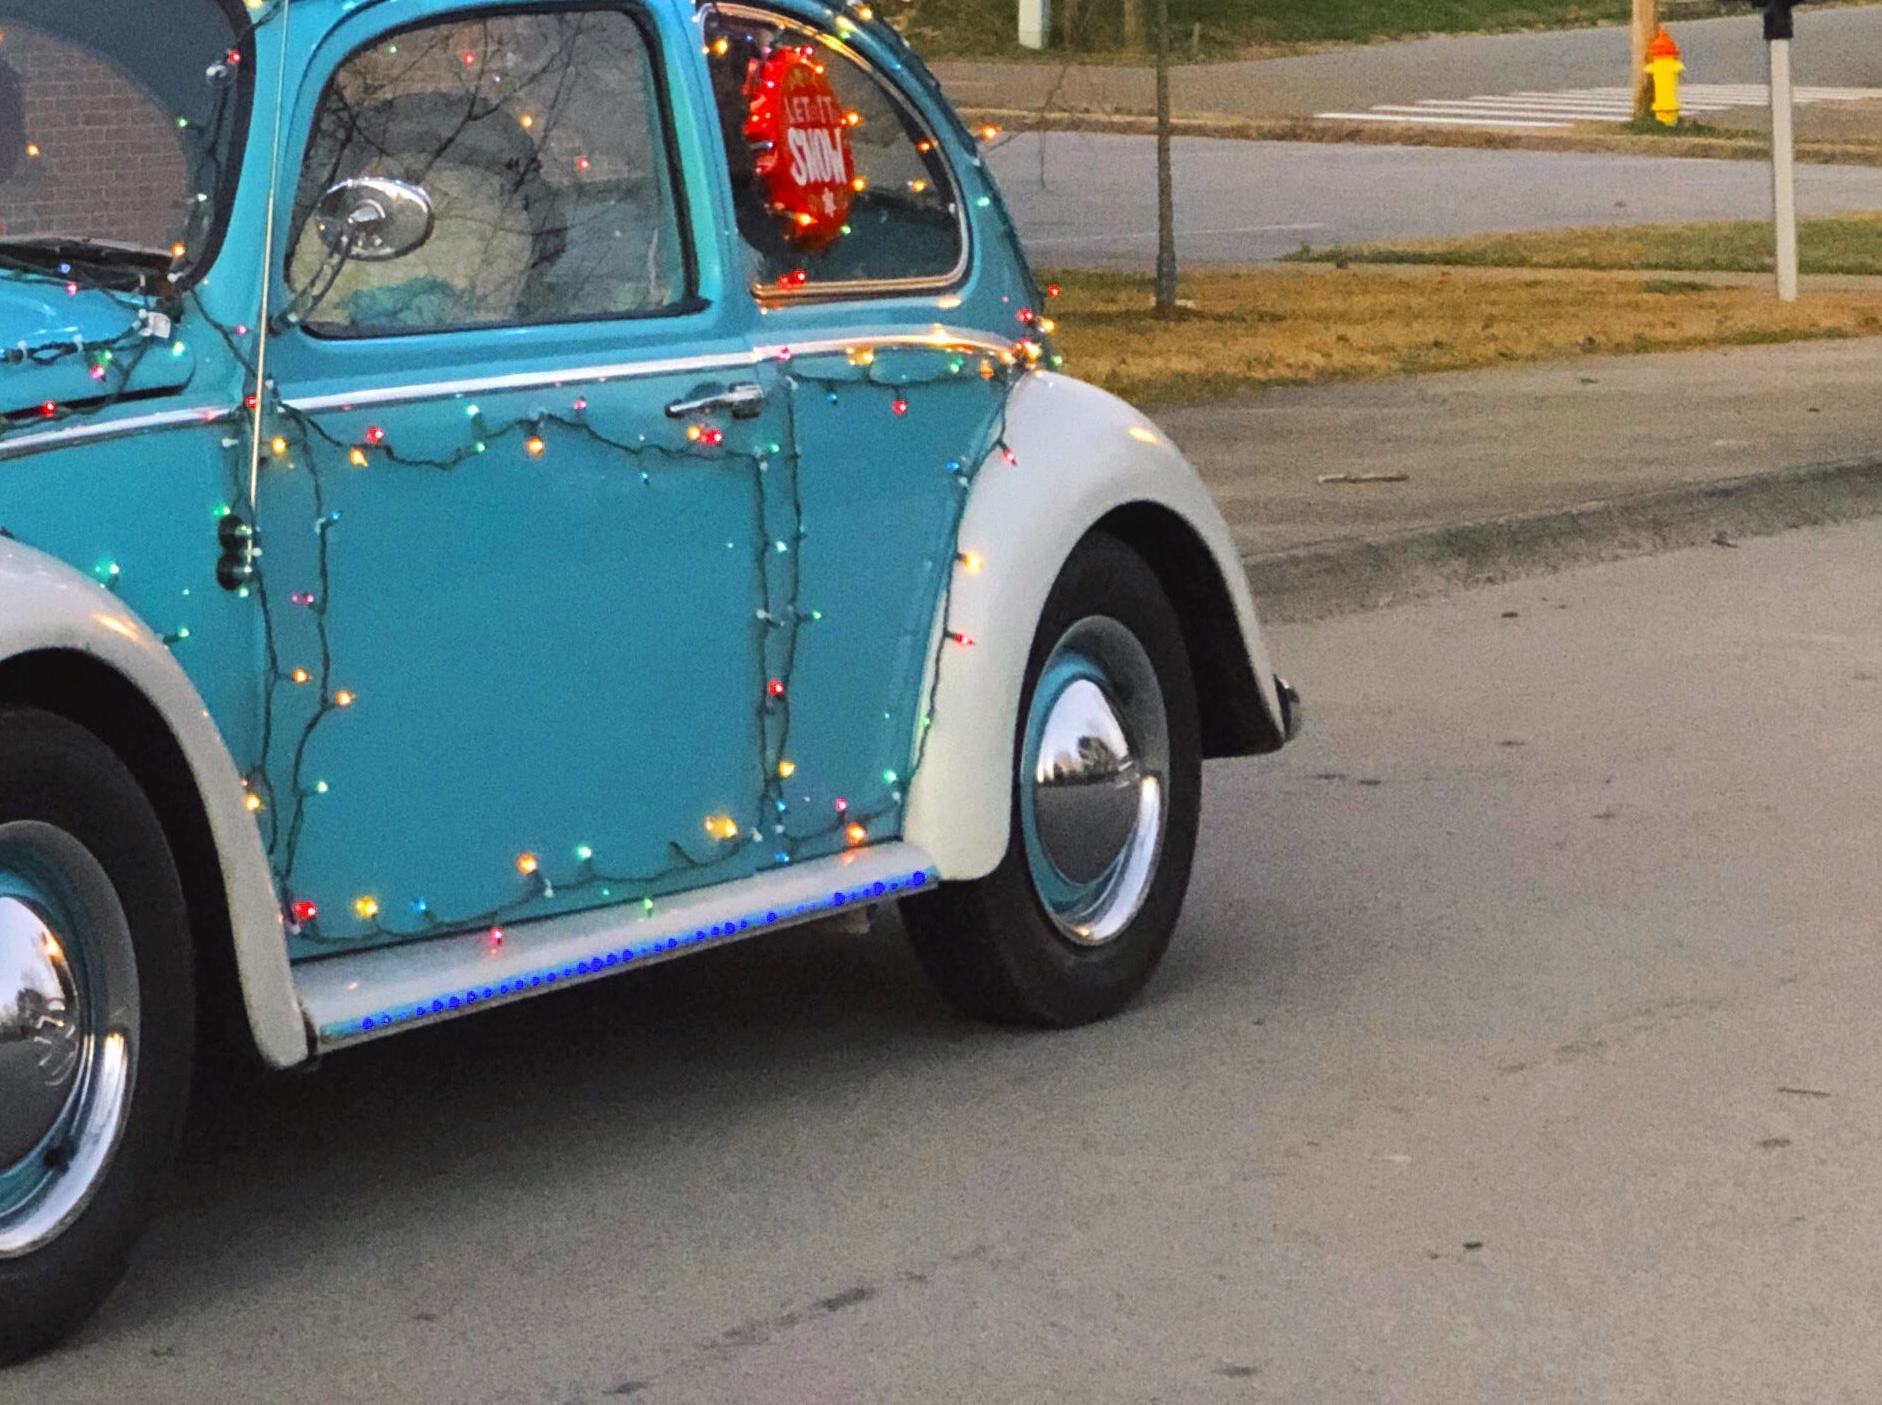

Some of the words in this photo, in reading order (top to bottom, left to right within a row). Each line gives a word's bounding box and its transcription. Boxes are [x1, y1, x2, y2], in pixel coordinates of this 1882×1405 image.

[784, 95, 811, 124] LET
[816, 94, 834, 124] IT
[787, 127, 847, 185] SNOW
